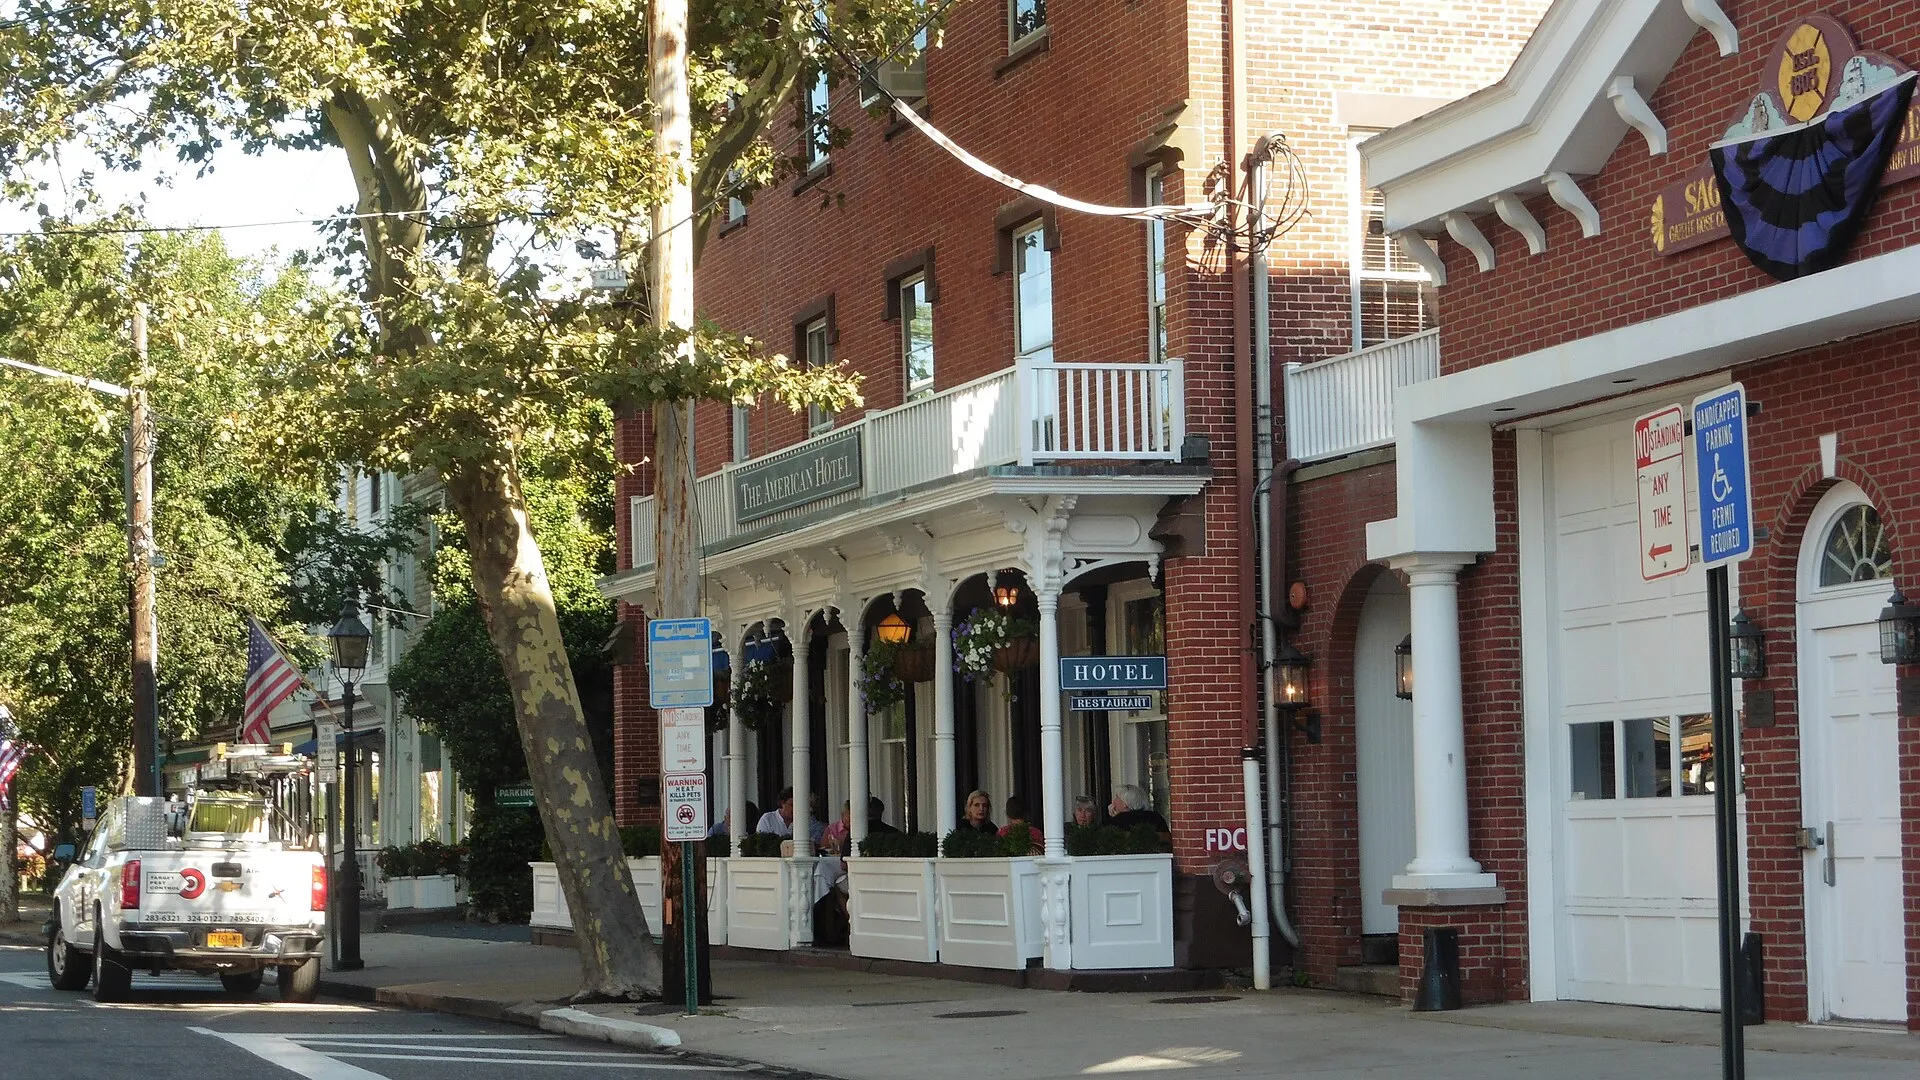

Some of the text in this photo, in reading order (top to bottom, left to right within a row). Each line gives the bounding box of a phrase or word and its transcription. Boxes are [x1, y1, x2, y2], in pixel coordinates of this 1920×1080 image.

[1685, 175, 1721, 218] SAG
[1669, 219, 1695, 243] GAZELLE
[1696, 212, 1715, 235] HOSE
[1696, 397, 1739, 430] HANDICAPPED
[1636, 422, 1681, 460] NO STANDING
[1705, 423, 1733, 452] PARKING
[741, 456, 852, 510] THE AMERICAN HOTEL
[1652, 472, 1669, 497] ANY
[1652, 505, 1672, 529] TIME
[1711, 502, 1735, 530] PERMIT
[1710, 528, 1740, 554] REQUIRED
[1073, 664, 1154, 681] HOTEL
[1077, 698, 1148, 708] RESTAURANT
[664, 711, 675, 724] NO
[676, 731, 691, 740] ANY
[676, 743, 692, 753] TIME
[499, 789, 535, 797] PARKING
[1206, 828, 1246, 851] FDC
[229, 915, 265, 923] 749-5402
